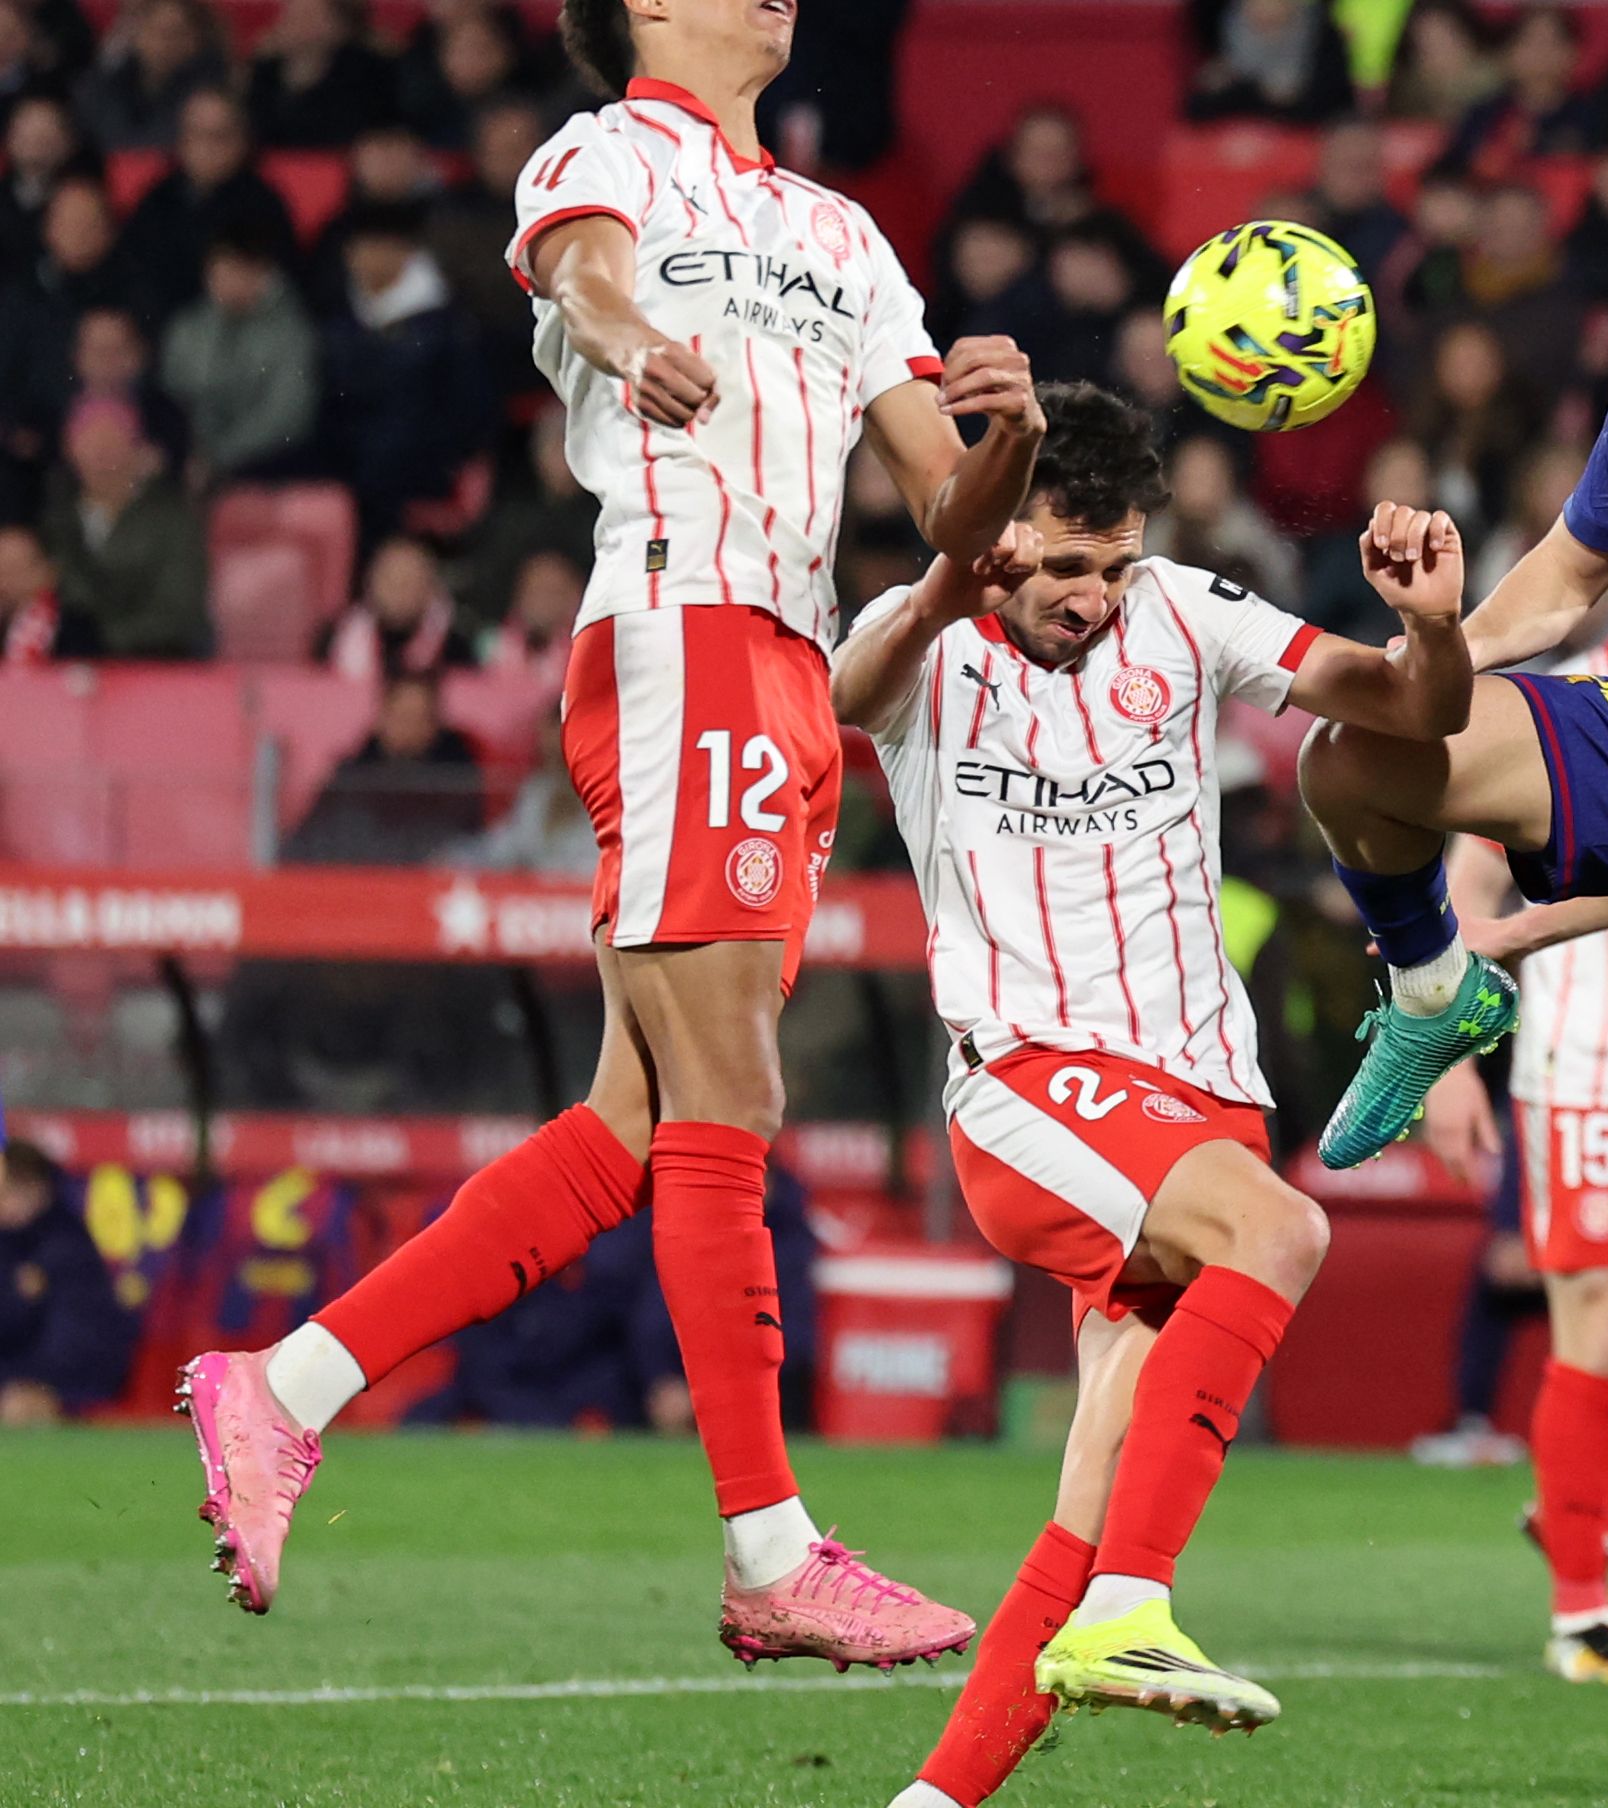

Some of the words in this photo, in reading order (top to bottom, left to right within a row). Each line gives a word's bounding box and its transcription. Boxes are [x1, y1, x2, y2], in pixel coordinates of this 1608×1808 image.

[1112, 668, 1152, 690] GIRONA
[696, 730, 789, 833] 12
[955, 759, 1175, 808] ETIHAD
[996, 809, 1138, 836] AIRWAYS
[1048, 1066, 1128, 1121] 2
